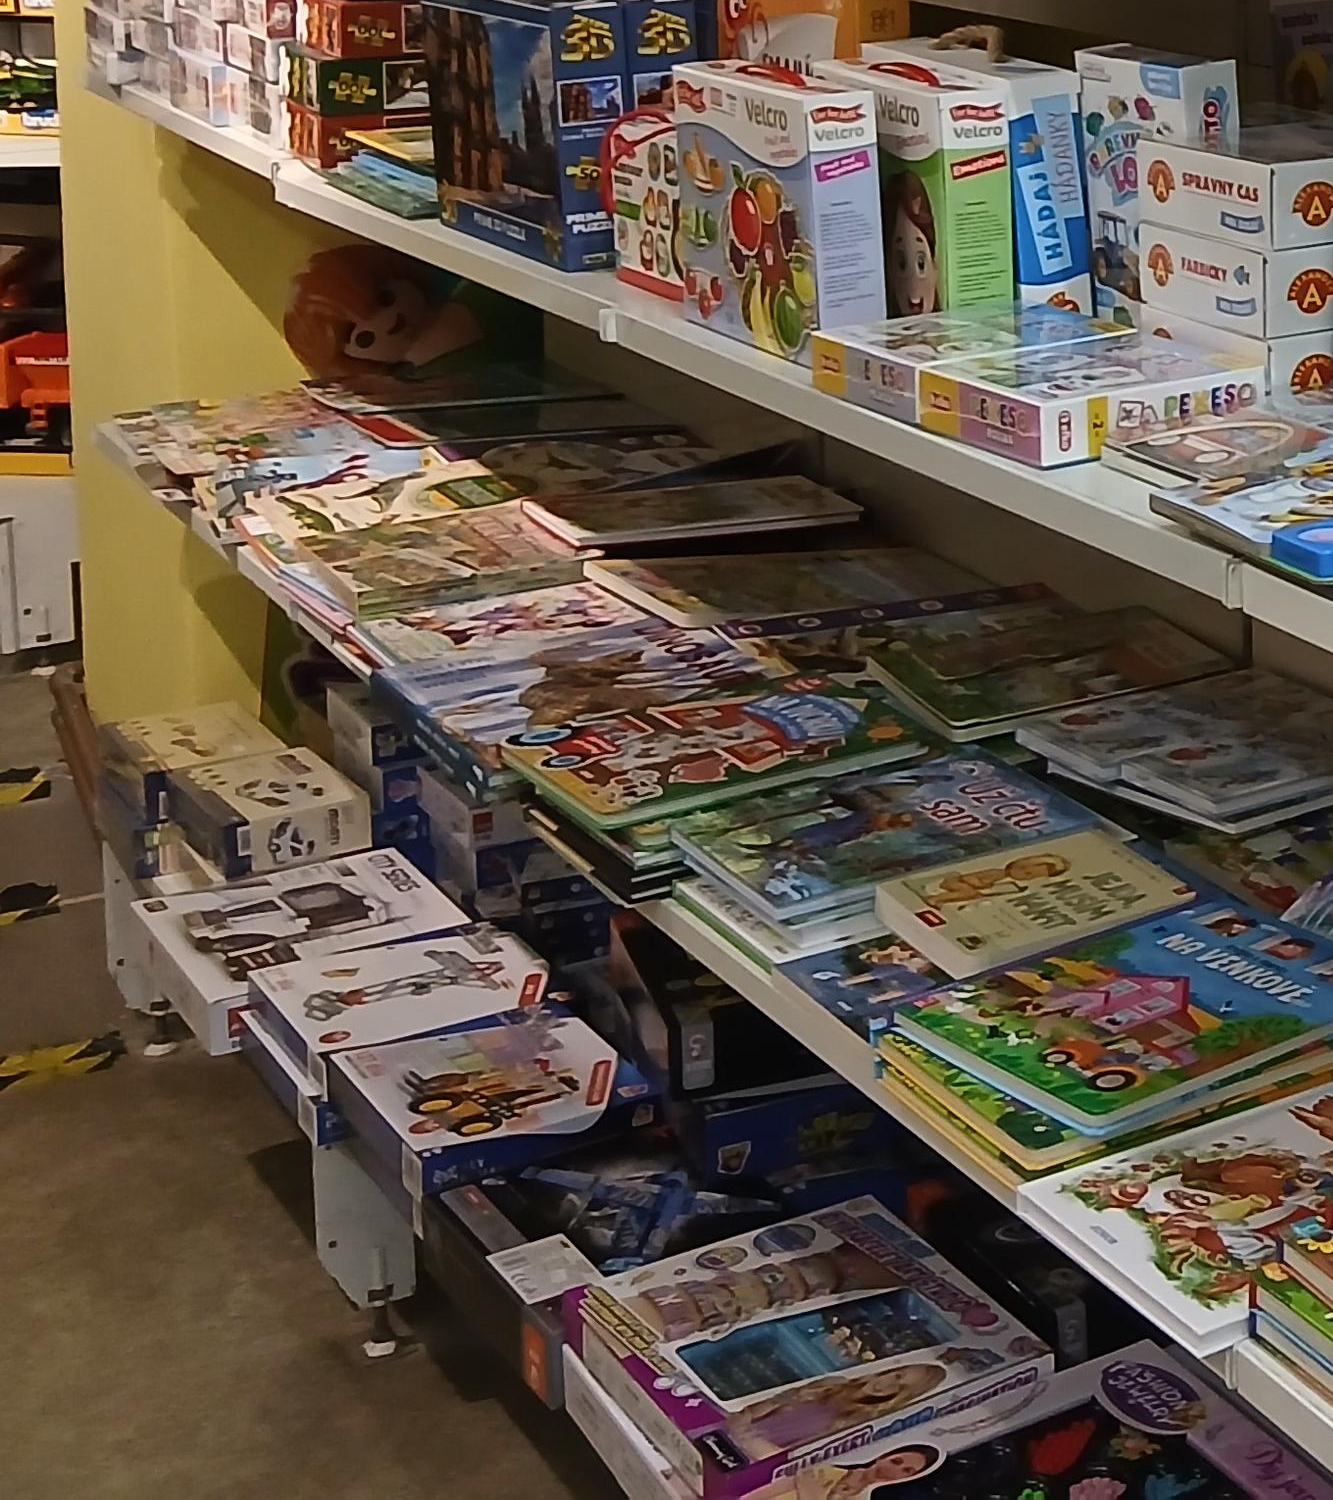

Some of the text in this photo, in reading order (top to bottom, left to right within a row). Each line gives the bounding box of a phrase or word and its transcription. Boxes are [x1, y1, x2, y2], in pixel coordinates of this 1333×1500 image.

[744, 98, 788, 131] Velcro
[879, 93, 920, 128] Velcro
[813, 126, 865, 142] Velcro
[953, 125, 1003, 140] Velcro
[1036, 170, 1064, 262] HÁDAJ
[1165, 381, 1258, 418] PEXESO
[1156, 931, 1320, 1008] NA VENKOVĚ
